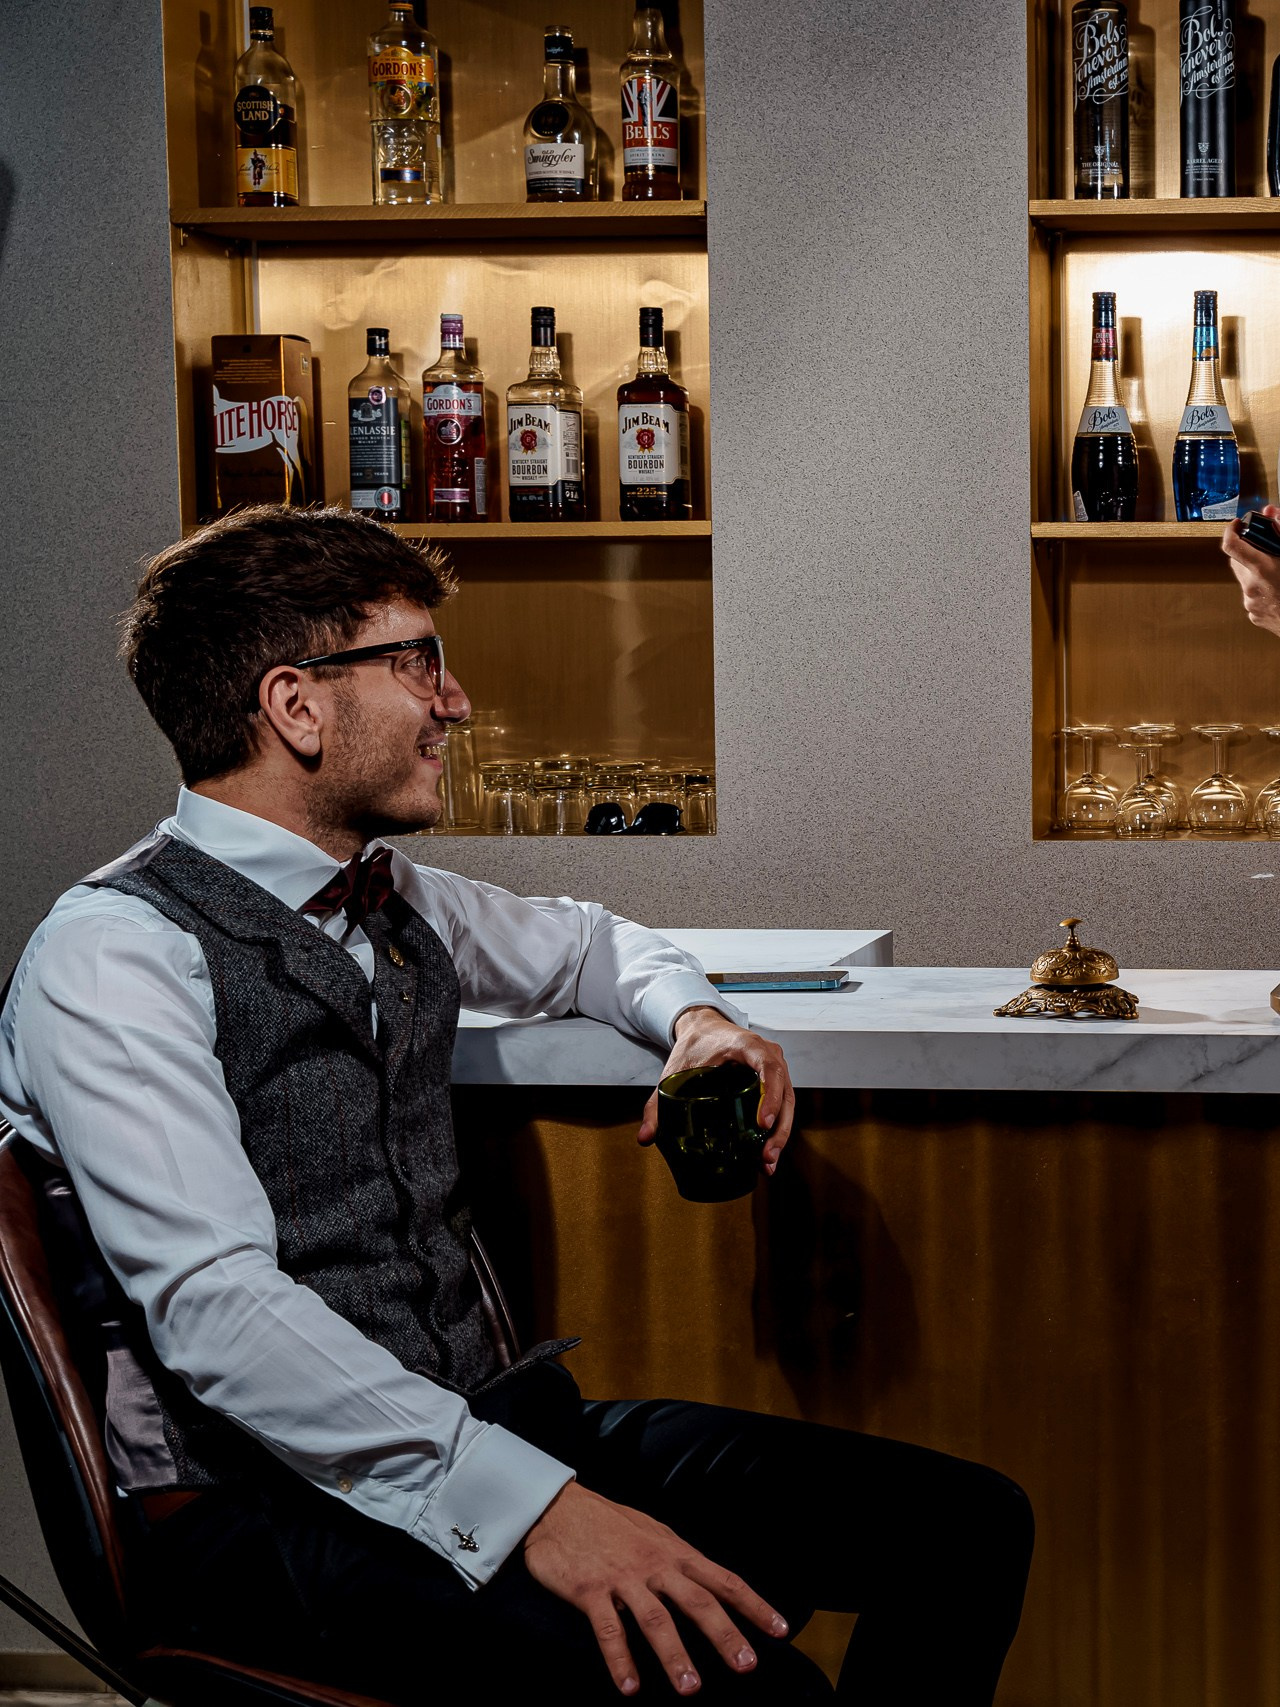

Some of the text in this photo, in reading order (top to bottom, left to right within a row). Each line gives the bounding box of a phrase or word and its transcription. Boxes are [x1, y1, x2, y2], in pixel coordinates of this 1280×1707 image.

[1076, 12, 1120, 62] Bols
[372, 61, 424, 76] GORDON'S
[237, 101, 274, 112] SCOTTISH
[242, 110, 269, 121] LAND
[626, 123, 670, 140] BELL'S
[528, 148, 576, 167] Smuggler
[427, 397, 473, 410] GORDON'S
[248, 400, 298, 440] HORSE
[509, 413, 552, 436] JIM BEAM
[622, 412, 671, 435] JIM BEAM
[1088, 406, 1117, 432] Bols
[1186, 406, 1216, 432] Bols
[350, 426, 396, 436] LENLASSIE
[512, 465, 548, 475] BOURBON
[628, 460, 664, 470] BOURBON
